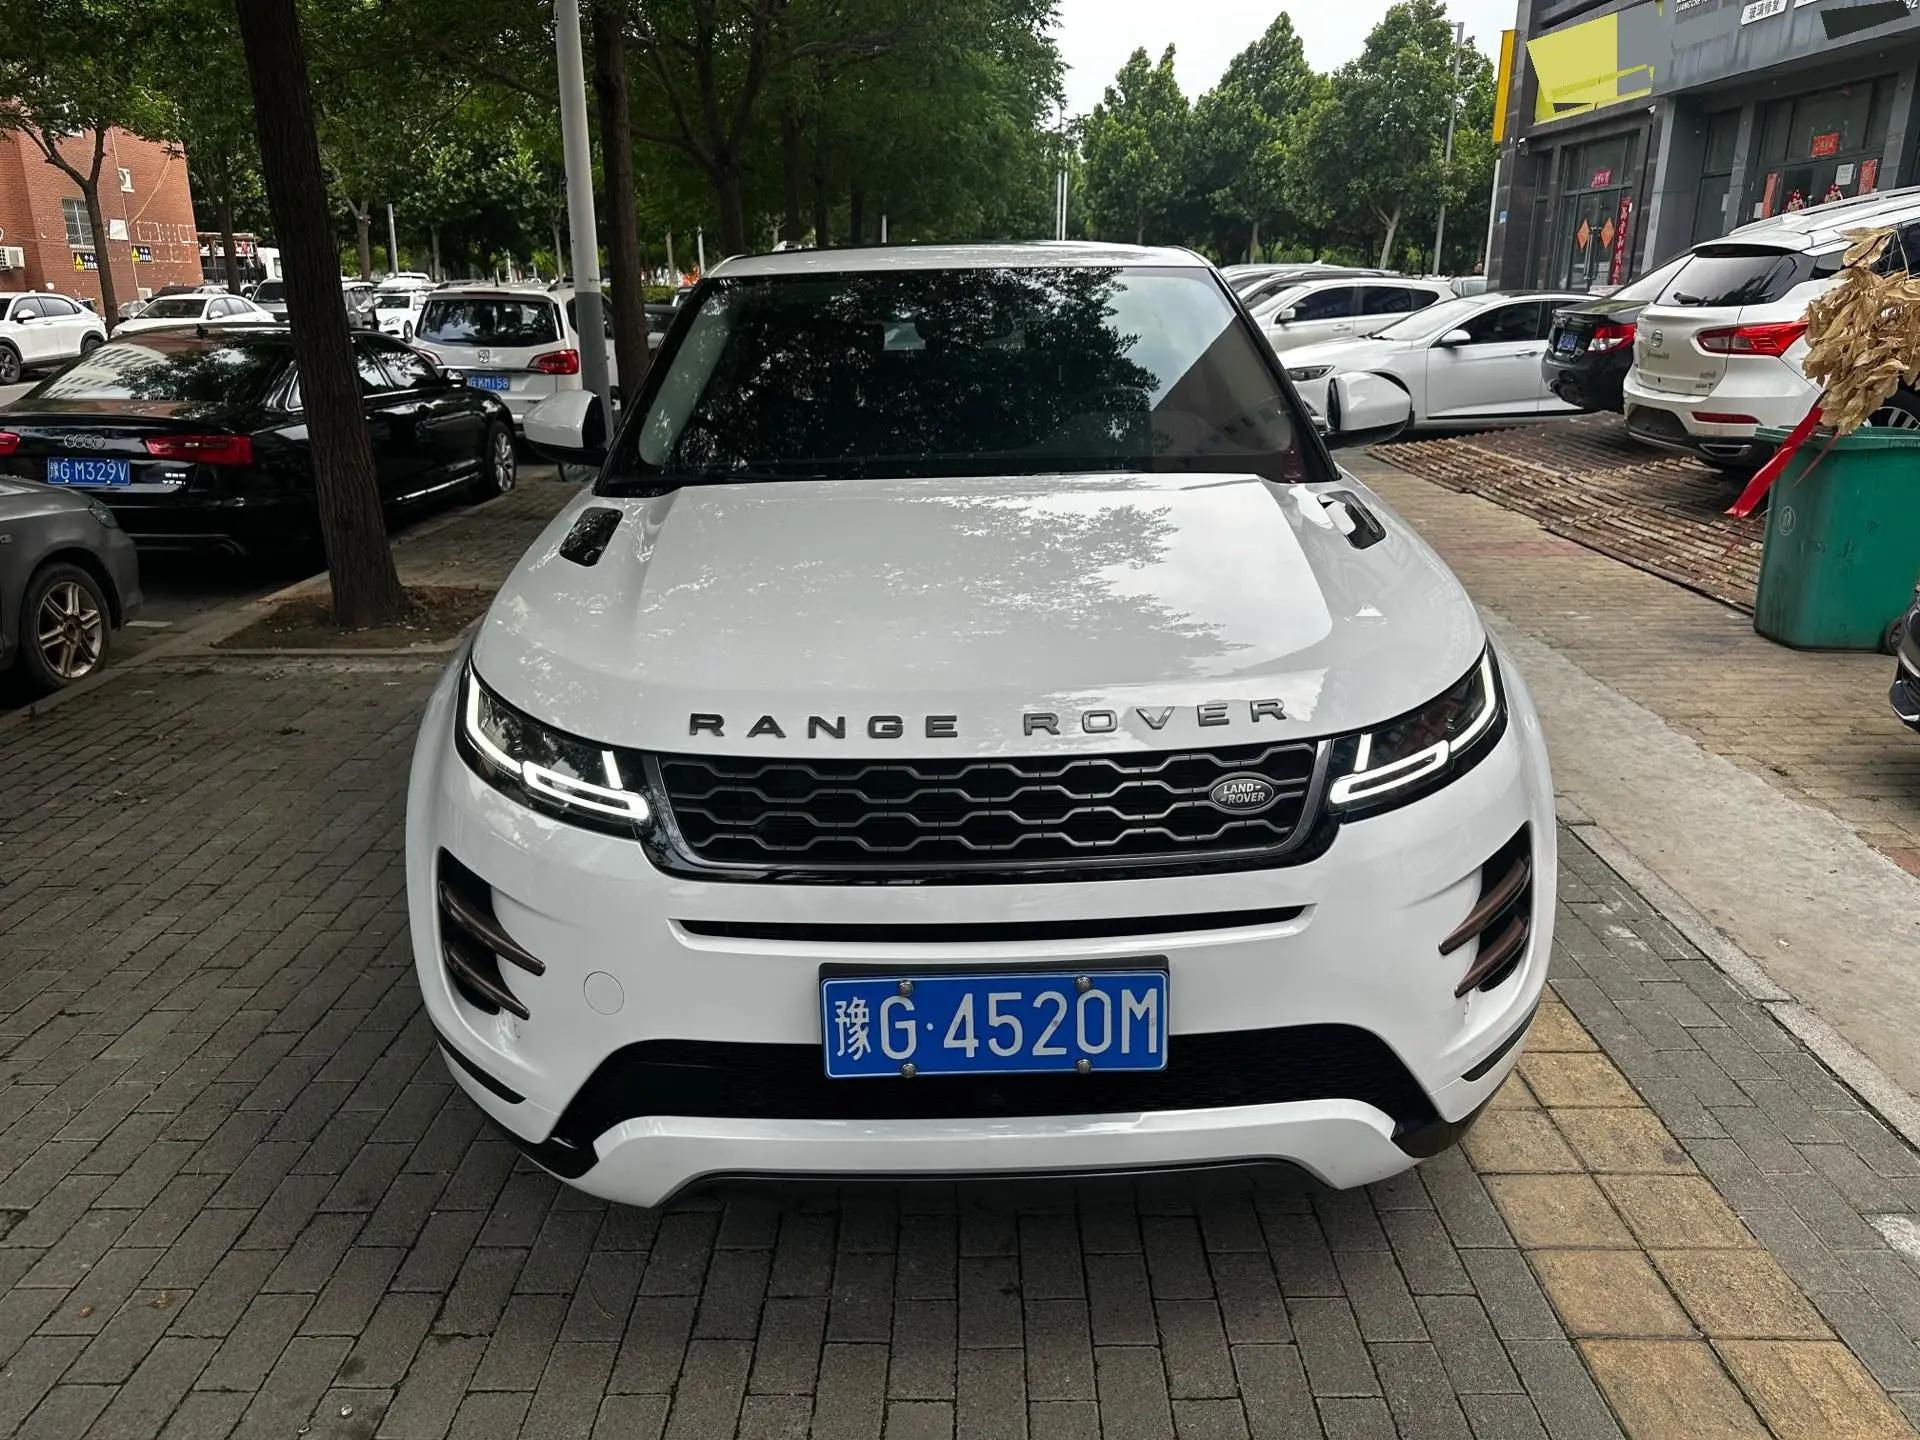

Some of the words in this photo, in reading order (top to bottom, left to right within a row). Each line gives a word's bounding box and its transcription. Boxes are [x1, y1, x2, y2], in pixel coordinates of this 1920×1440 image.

[688, 712, 958, 739] RANGE
[1023, 698, 1287, 736] ROVER
[1223, 783, 1254, 794] LAND
[1227, 792, 1265, 804] ROVER
[834, 987, 1158, 1061] 豫G·4520M
